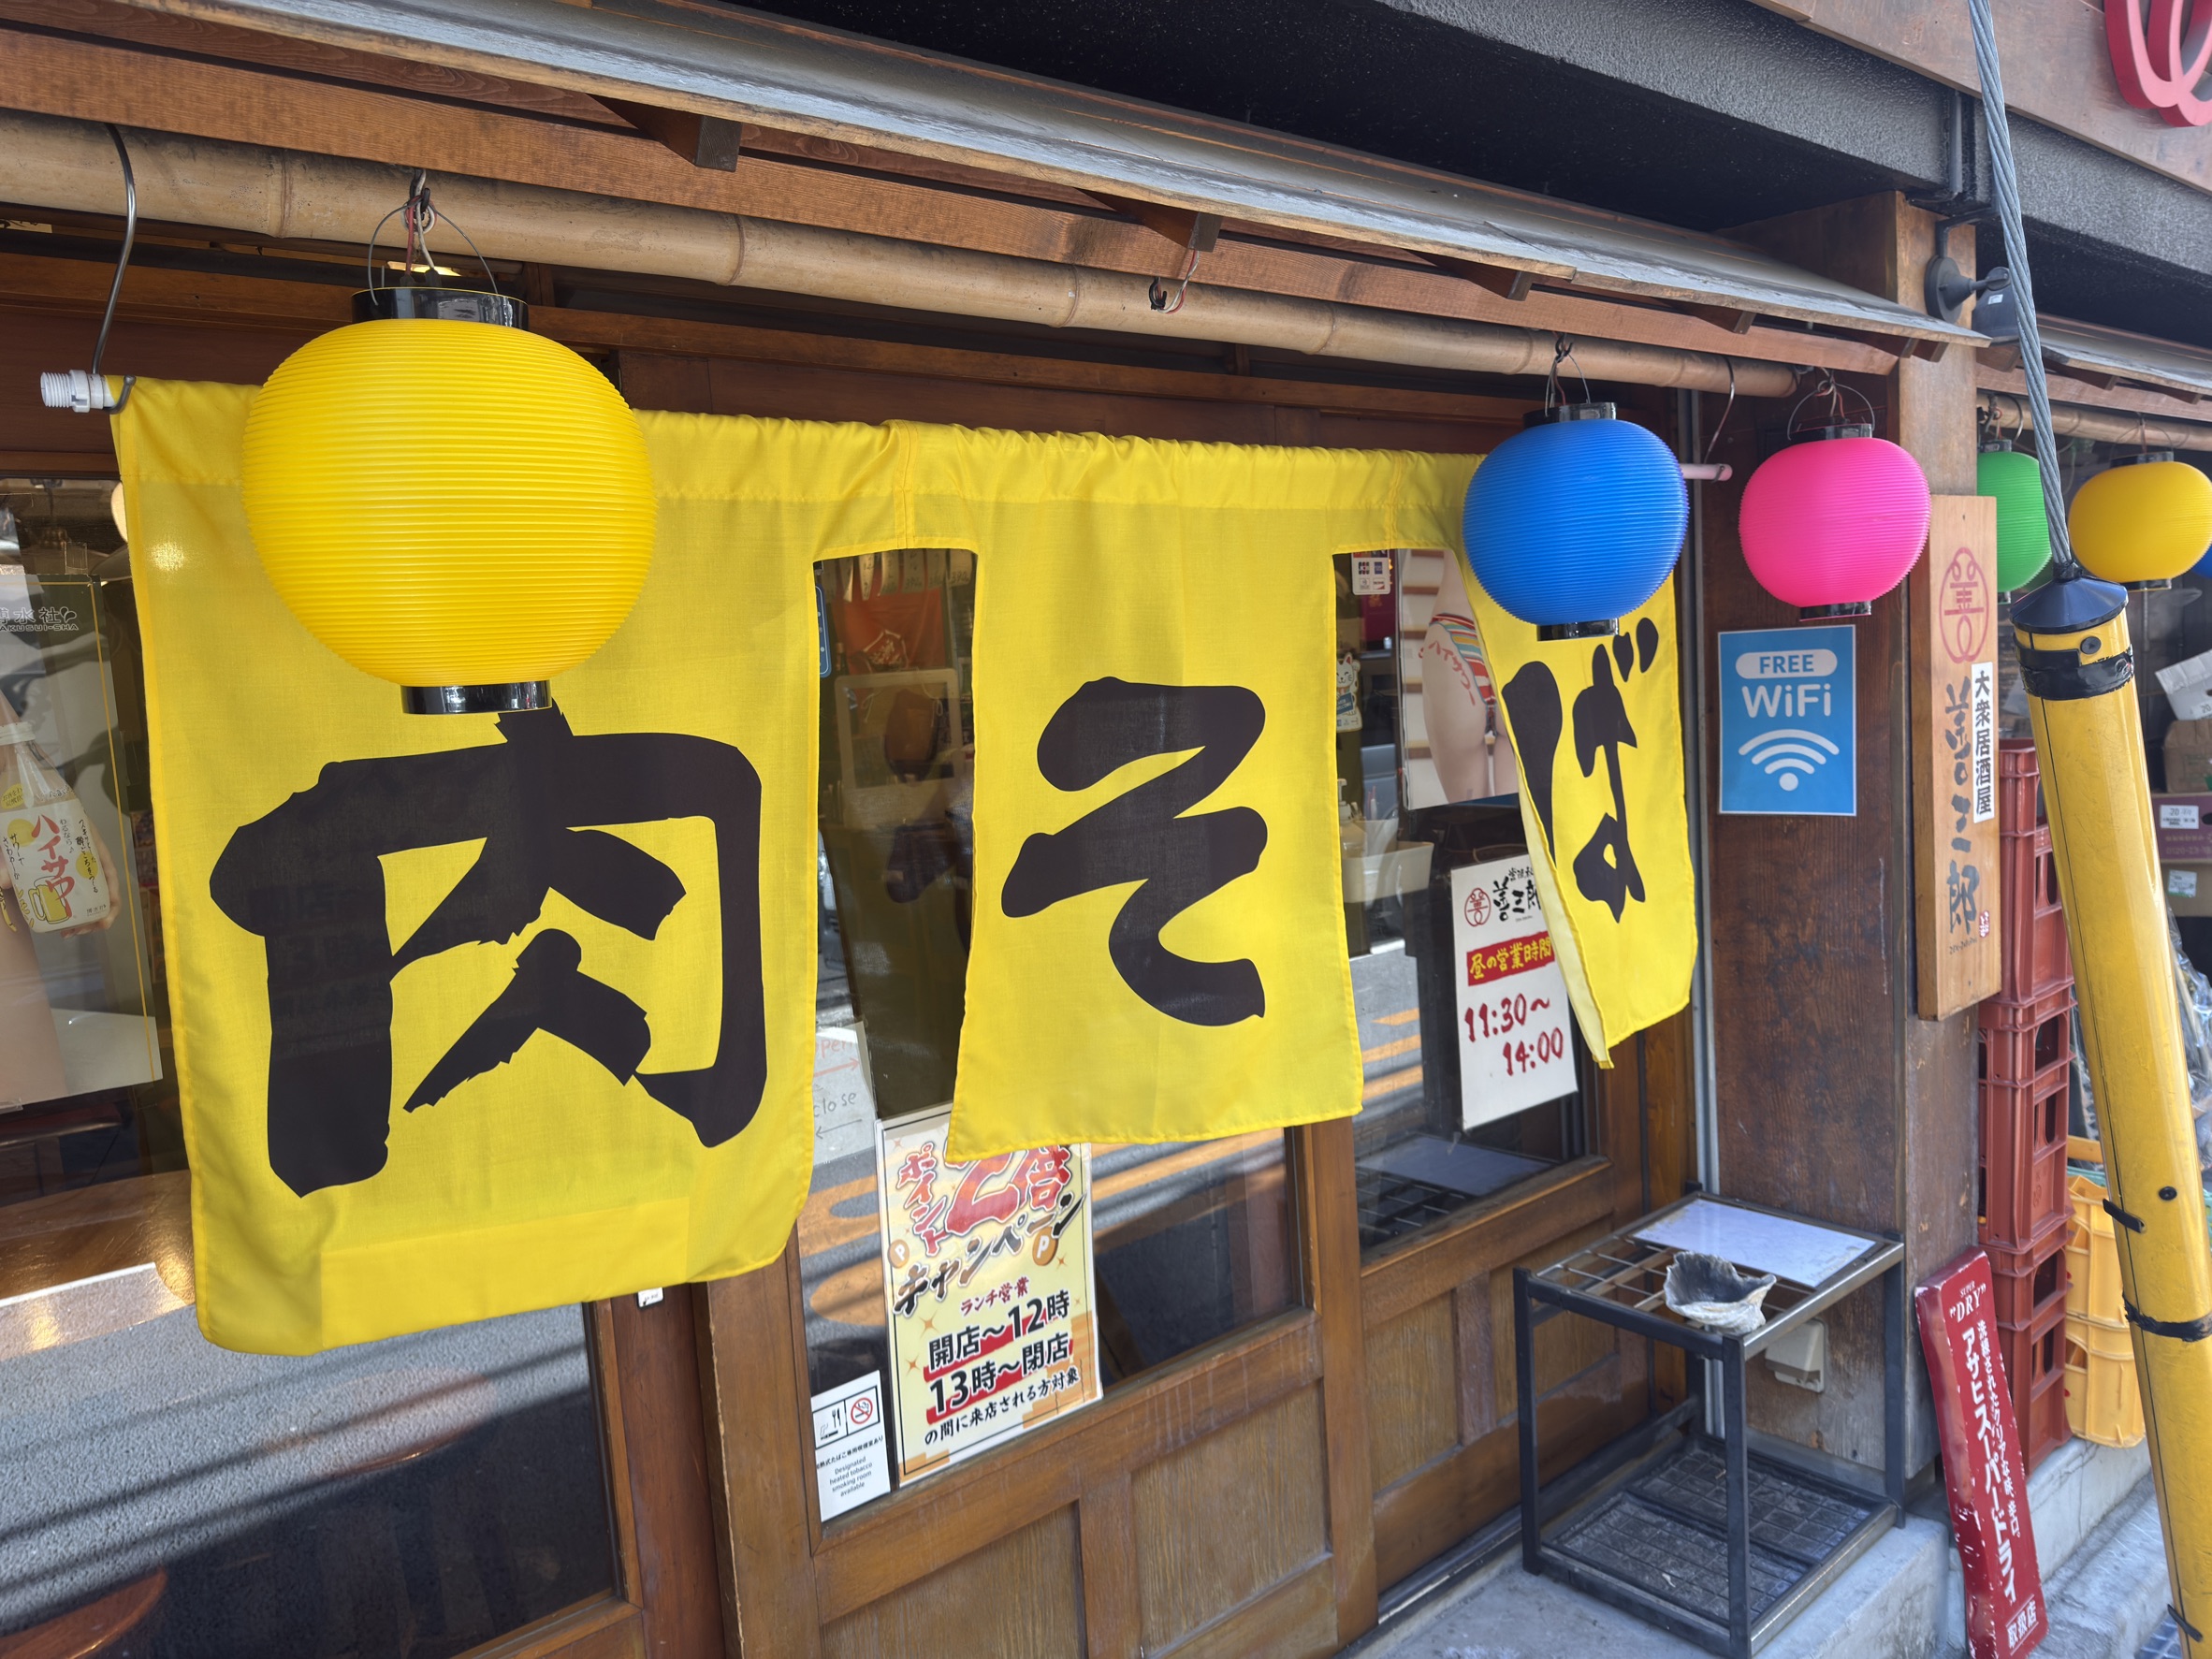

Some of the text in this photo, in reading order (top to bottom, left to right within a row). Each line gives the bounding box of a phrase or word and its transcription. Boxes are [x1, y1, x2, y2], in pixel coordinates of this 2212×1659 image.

[1428, 640, 1476, 706] ハイサワー
[1759, 654, 1814, 674] FREE
[1741, 683, 1831, 719] WiFi
[1974, 670, 1991, 816] 大衆居酒屋
[32, 814, 75, 918] ハイサワー
[1469, 937, 1552, 980] 昼の営業時間
[1503, 1026, 1564, 1076] 14:00
[896, 1142, 952, 1255] ポイント
[894, 1193, 1085, 1317] キャンペーン
[961, 1276, 1029, 1316] ランチ営業
[1959, 1280, 1976, 1298] SUPER
[924, 1367, 1079, 1445] の間に来店される方対象
[829, 1462, 873, 1485] heated tobacco
[832, 1471, 872, 1492] smoking room
[835, 1456, 866, 1475] Designated
[1961, 1327, 2016, 1604] アサヒスーパードライ
[840, 1482, 866, 1497] available
[2007, 1600, 2038, 1650] 取扱店
